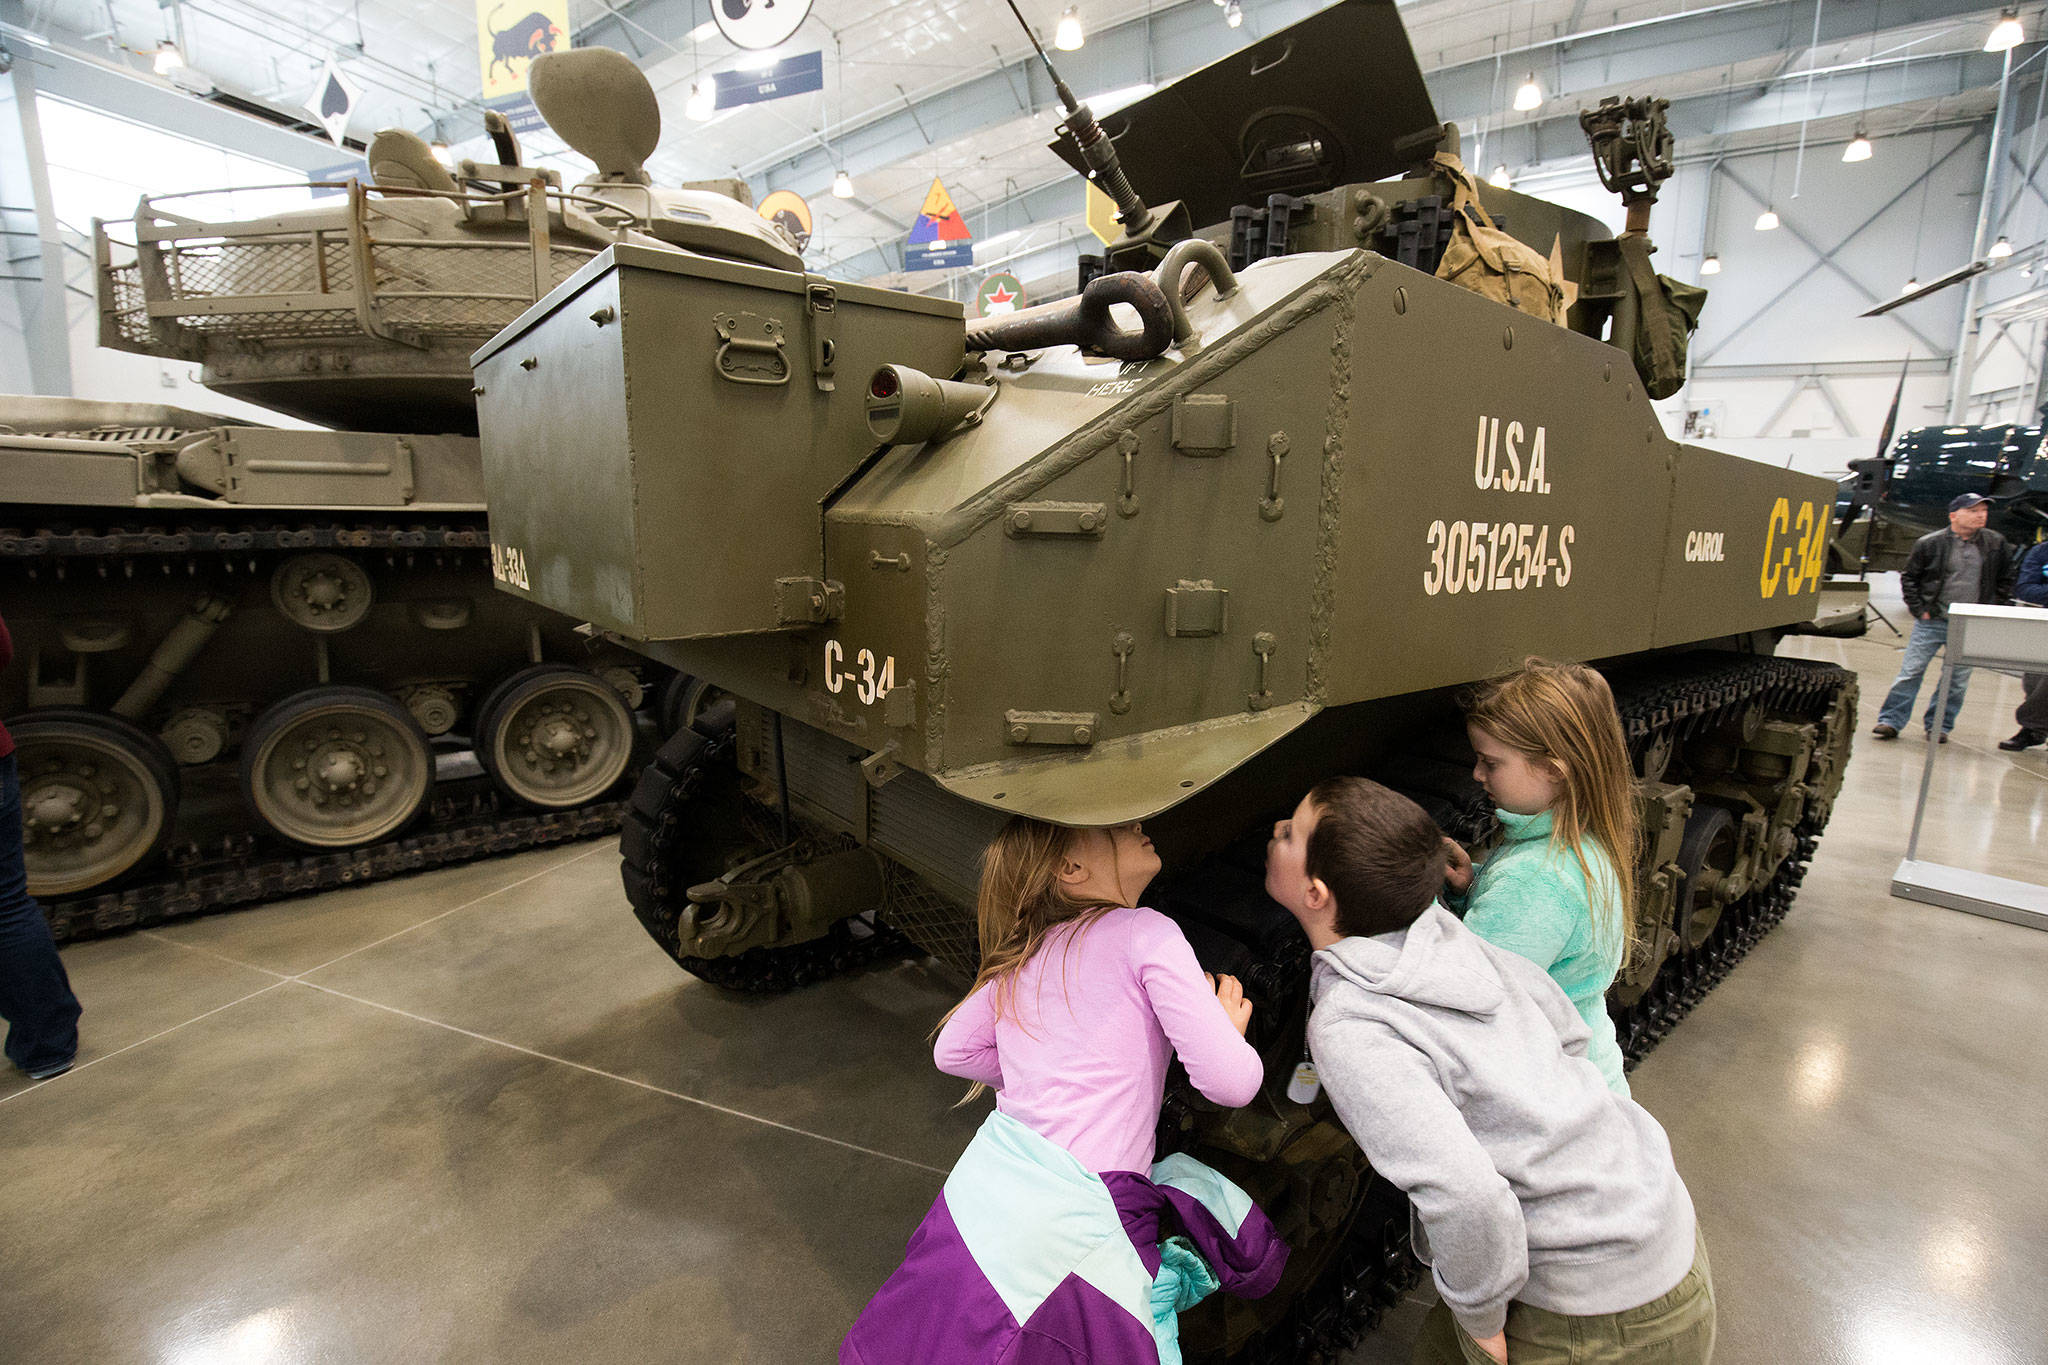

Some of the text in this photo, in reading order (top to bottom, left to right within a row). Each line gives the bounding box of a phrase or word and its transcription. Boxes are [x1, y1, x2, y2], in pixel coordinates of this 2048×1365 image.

[1084, 378, 1143, 399] HERE
[1475, 415, 1551, 494] U.S.A.
[1423, 519, 1576, 596] 3051254-S
[1685, 530, 1725, 562] CAROL
[1760, 497, 1830, 599] C-34
[824, 639, 895, 706] C-34
